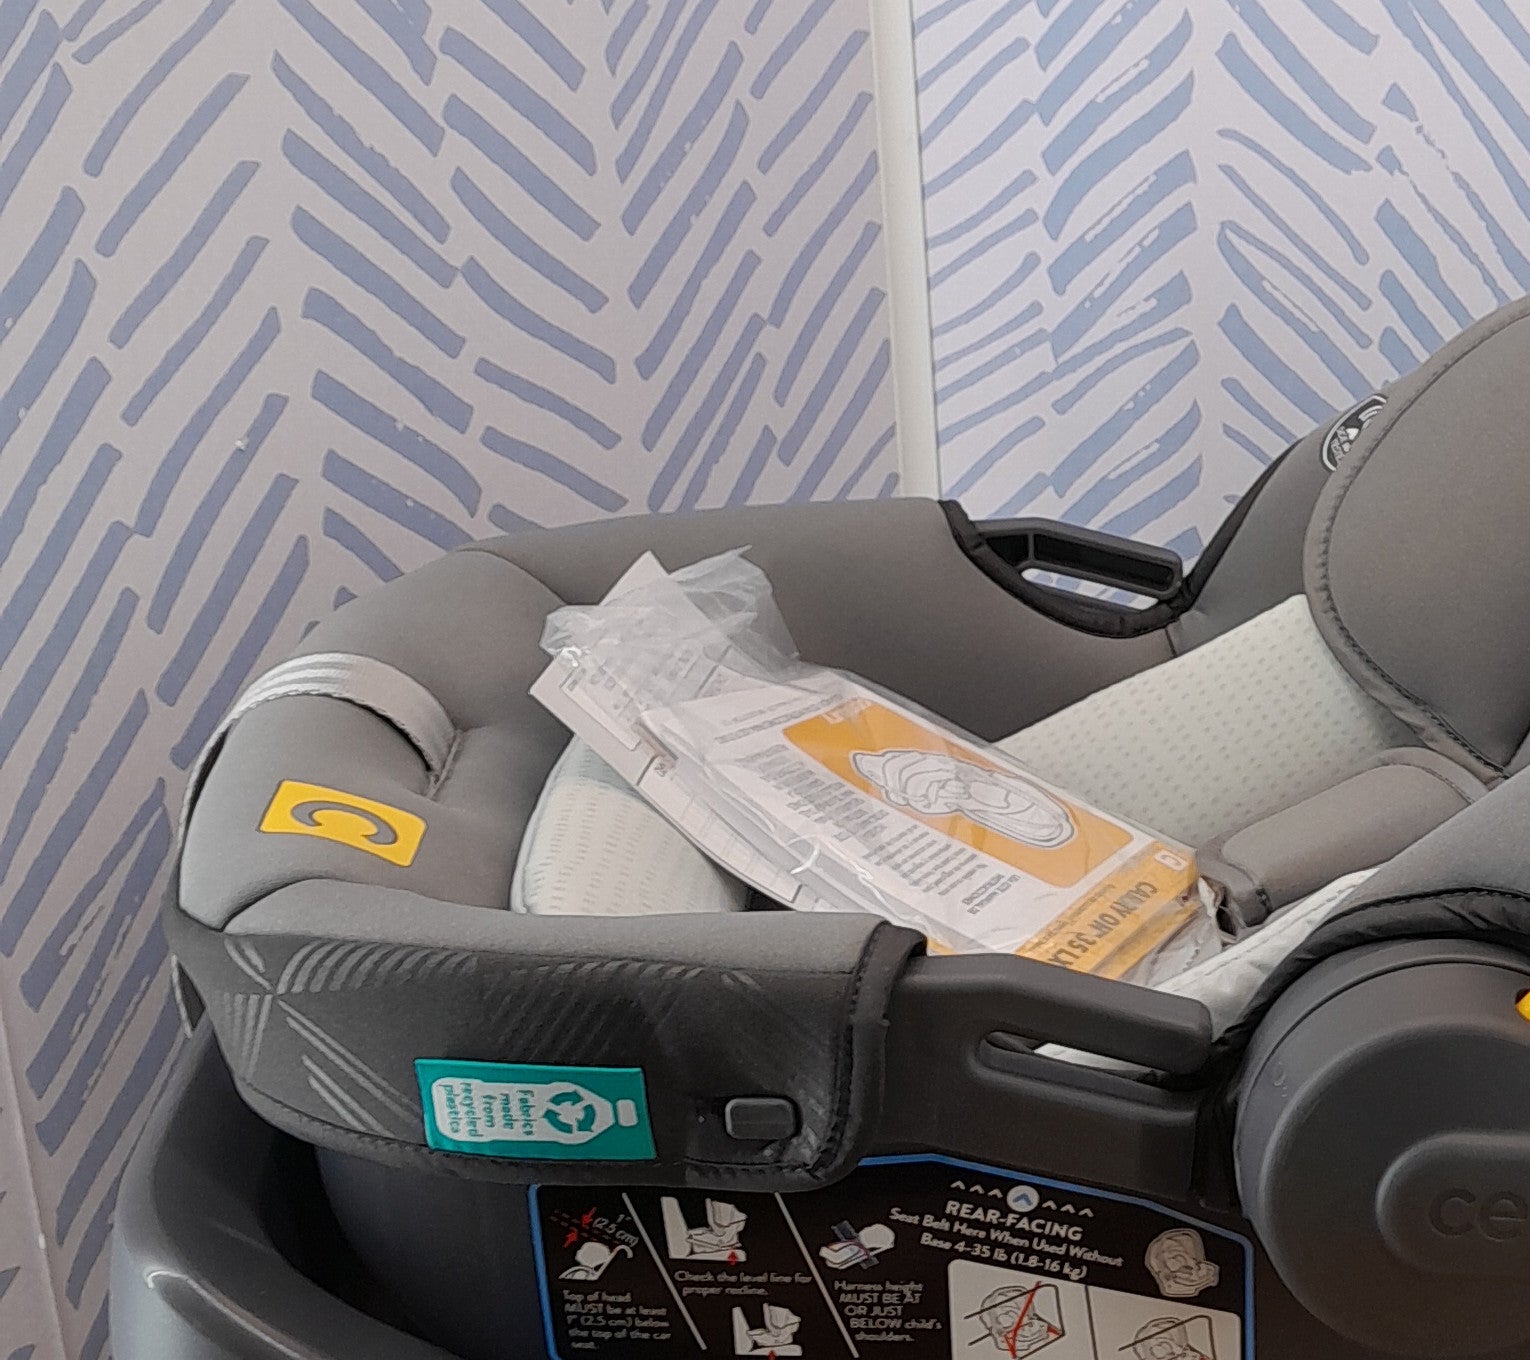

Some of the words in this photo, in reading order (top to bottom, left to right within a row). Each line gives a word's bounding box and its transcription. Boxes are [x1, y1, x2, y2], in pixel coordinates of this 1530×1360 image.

[438, 1083, 462, 1134] plastics
[459, 1082, 484, 1138] recycled
[482, 1094, 496, 1128] from
[517, 1089, 535, 1136] Fabrics
[888, 1206, 920, 1224] Seat
[921, 1213, 950, 1231] Belt
[952, 1220, 986, 1238] Here
[989, 1228, 1029, 1247] When
[1031, 1236, 1067, 1255] Used
[1068, 1245, 1123, 1266] Without
[945, 1200, 1082, 1240] REAR-FACING
[919, 1231, 952, 1249] Base
[953, 1240, 991, 1257] 4-35
[992, 1247, 1008, 1261] lb
[1062, 1261, 1087, 1280] kg)
[839, 1292, 878, 1303] MUST
[882, 1293, 900, 1303] BE
[844, 1305, 866, 1315] OR
[870, 1305, 903, 1316] JUST
[849, 1318, 902, 1328] BELOW
